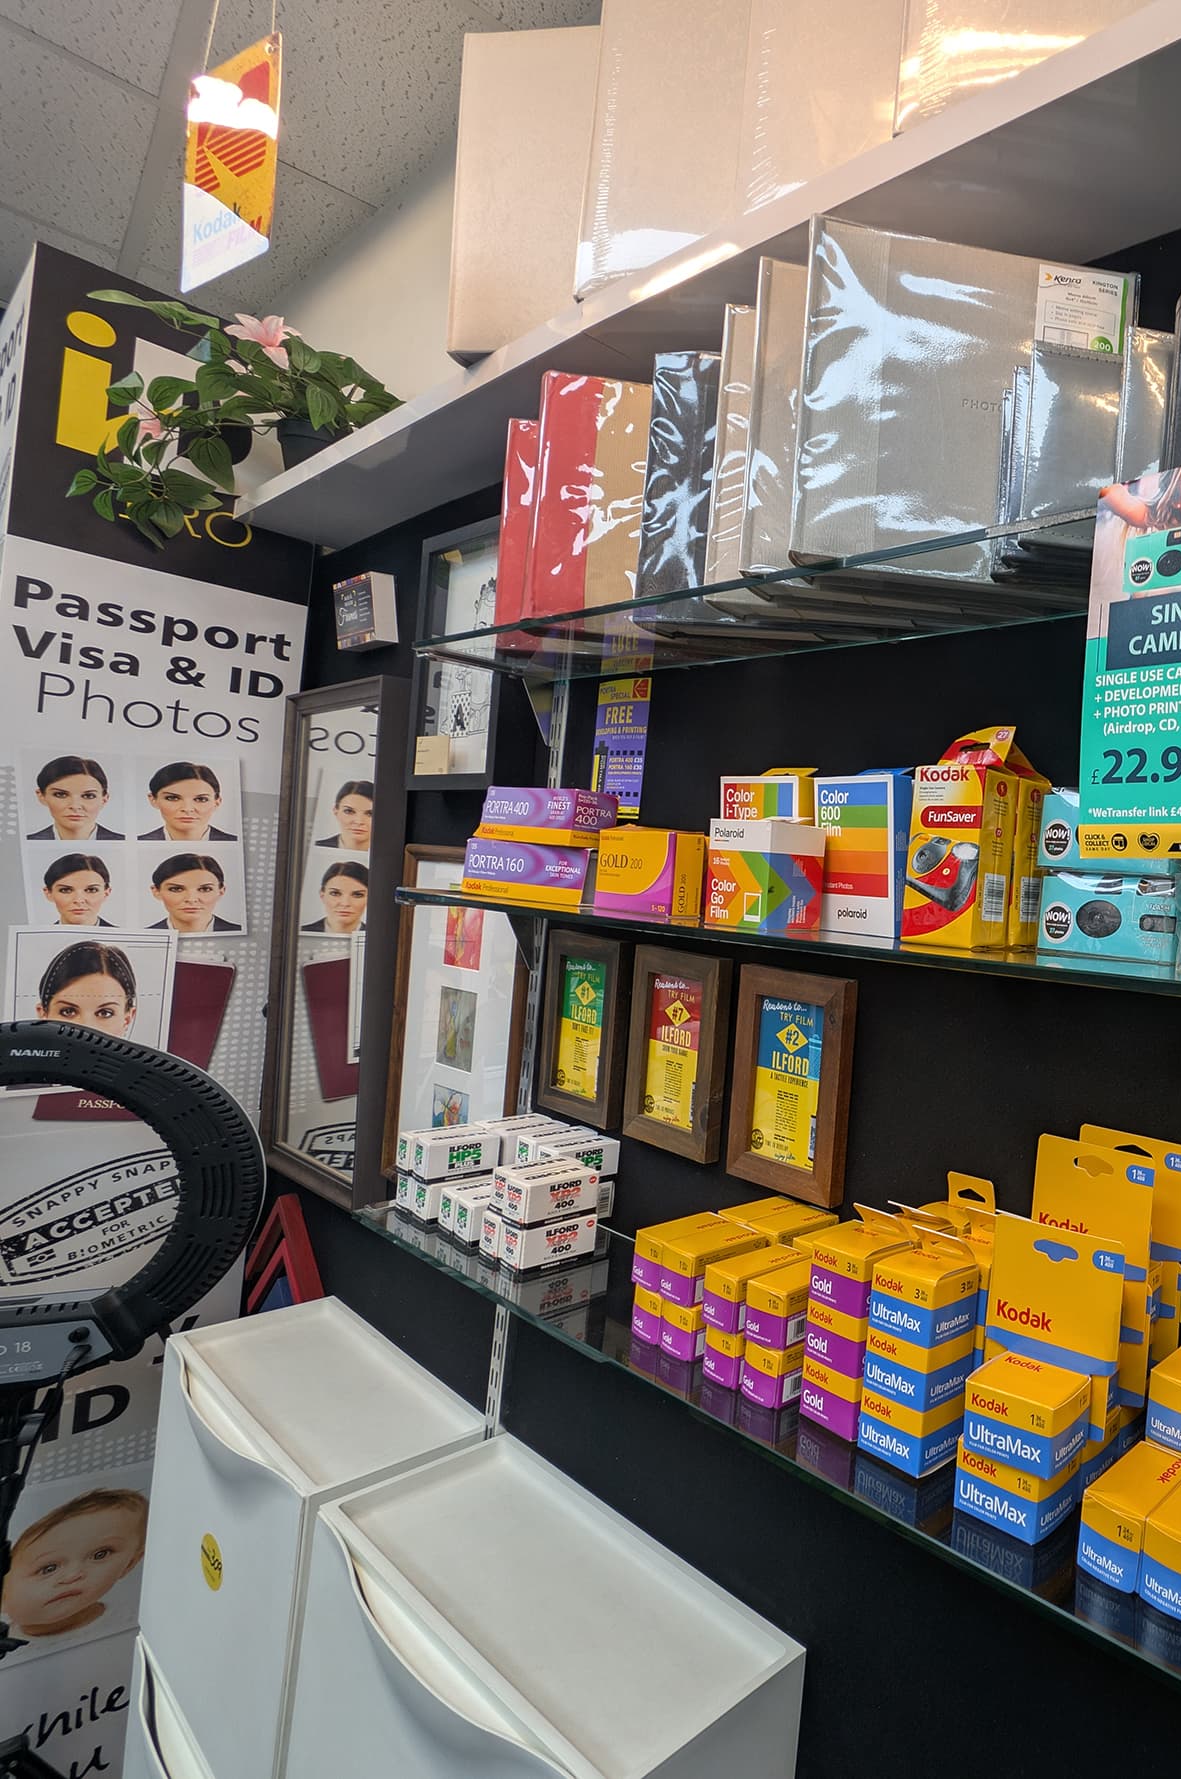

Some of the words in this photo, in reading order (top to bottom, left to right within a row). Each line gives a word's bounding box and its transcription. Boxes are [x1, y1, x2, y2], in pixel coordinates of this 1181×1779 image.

[1054, 275, 1082, 286] Kenro
[1098, 288, 1118, 297] SERIES
[1094, 341, 1110, 351] 200
[13, 575, 291, 662] Passport
[12, 624, 139, 677] Visa
[166, 656, 205, 688] &
[229, 667, 283, 699] ID
[1095, 671, 1137, 687] SINGLE
[1140, 668, 1164, 682] USE
[37, 671, 260, 743] Photos
[605, 704, 634, 725] FREE
[1104, 703, 1146, 718] PHOTO
[1103, 721, 1156, 736] (Airdrop,
[1159, 718, 1179, 732] CD,
[920, 766, 970, 783] Kodak
[726, 789, 755, 803] Color
[820, 789, 849, 804] Color
[485, 800, 513, 814] PORTRA
[513, 802, 529, 815] 400
[547, 801, 571, 810] FINEST
[576, 806, 612, 818] PORTRA
[726, 804, 758, 819] i-Type
[1149, 805, 1168, 817] link
[575, 815, 597, 826] 400
[820, 806, 840, 821] 600
[928, 810, 976, 823] FunSaver
[714, 827, 744, 839] Polaroid
[1045, 828, 1071, 840] WOW!
[469, 854, 504, 870] PORTRA
[506, 858, 524, 872] 160
[600, 854, 628, 868] GOLD
[630, 858, 642, 870] 200
[545, 866, 581, 874] EXCEPTIONAL
[711, 879, 737, 893] Color
[710, 892, 724, 906] Go
[710, 906, 729, 919] Film
[837, 907, 867, 920] polaroid
[1045, 910, 1071, 924] WOW!
[581, 986, 590, 1000] #1
[668, 990, 678, 999] TRY
[680, 992, 695, 1003] FILM
[763, 999, 792, 1011] Reasons
[571, 1004, 597, 1024] ILFORD
[672, 1007, 683, 1021] #7
[779, 1012, 794, 1023] TRY
[795, 1015, 814, 1027] FILM
[661, 1025, 691, 1047] ILFORD
[785, 1030, 799, 1047] #2
[10, 1049, 61, 1057] NANLITE
[772, 1051, 810, 1076] ILFORD
[449, 1142, 481, 1153] ILFORD
[575, 1148, 603, 1158] ILFORD
[449, 1149, 481, 1163] HP5
[550, 1180, 582, 1192] ILFORD
[12, 1180, 98, 1227] SNAPPY
[111, 1161, 171, 1183] SNAP
[555, 1200, 575, 1209] 400
[24, 1179, 181, 1252] ACCEPTE
[102, 1220, 130, 1236] FOR
[546, 1224, 579, 1237] ILFORD
[551, 1244, 571, 1254] 400
[814, 1248, 838, 1268] Kodak
[633, 1265, 644, 1277] Gold
[661, 1279, 672, 1291] Gold
[811, 1274, 832, 1295] Gold
[875, 1273, 903, 1293] Kodak
[704, 1303, 716, 1316] Gold
[809, 1306, 833, 1326] Kodak
[872, 1300, 921, 1333] UltraMax
[996, 1299, 1052, 1332] Kodak
[634, 1316, 643, 1328] Gold
[746, 1319, 760, 1333] Gold
[935, 1312, 970, 1333] UltraMax
[662, 1332, 672, 1344] Gold
[807, 1333, 828, 1353] Gold
[869, 1334, 897, 1356] Kodak
[15, 1342, 32, 1353] 18
[704, 1357, 715, 1370] Gold
[805, 1362, 829, 1385] Kodak
[867, 1364, 915, 1397] UltraMax
[930, 1374, 965, 1397] UltraMax
[803, 1389, 824, 1411] Gold
[864, 1395, 892, 1418] Kodak
[971, 1392, 1009, 1417] Kodak
[861, 1422, 910, 1459] UltraMax
[969, 1421, 1041, 1463] UltraMax
[1055, 1429, 1085, 1462] UltraMax
[959, 1479, 1027, 1527] UltraMax
[1082, 1542, 1124, 1578] UltraMax
